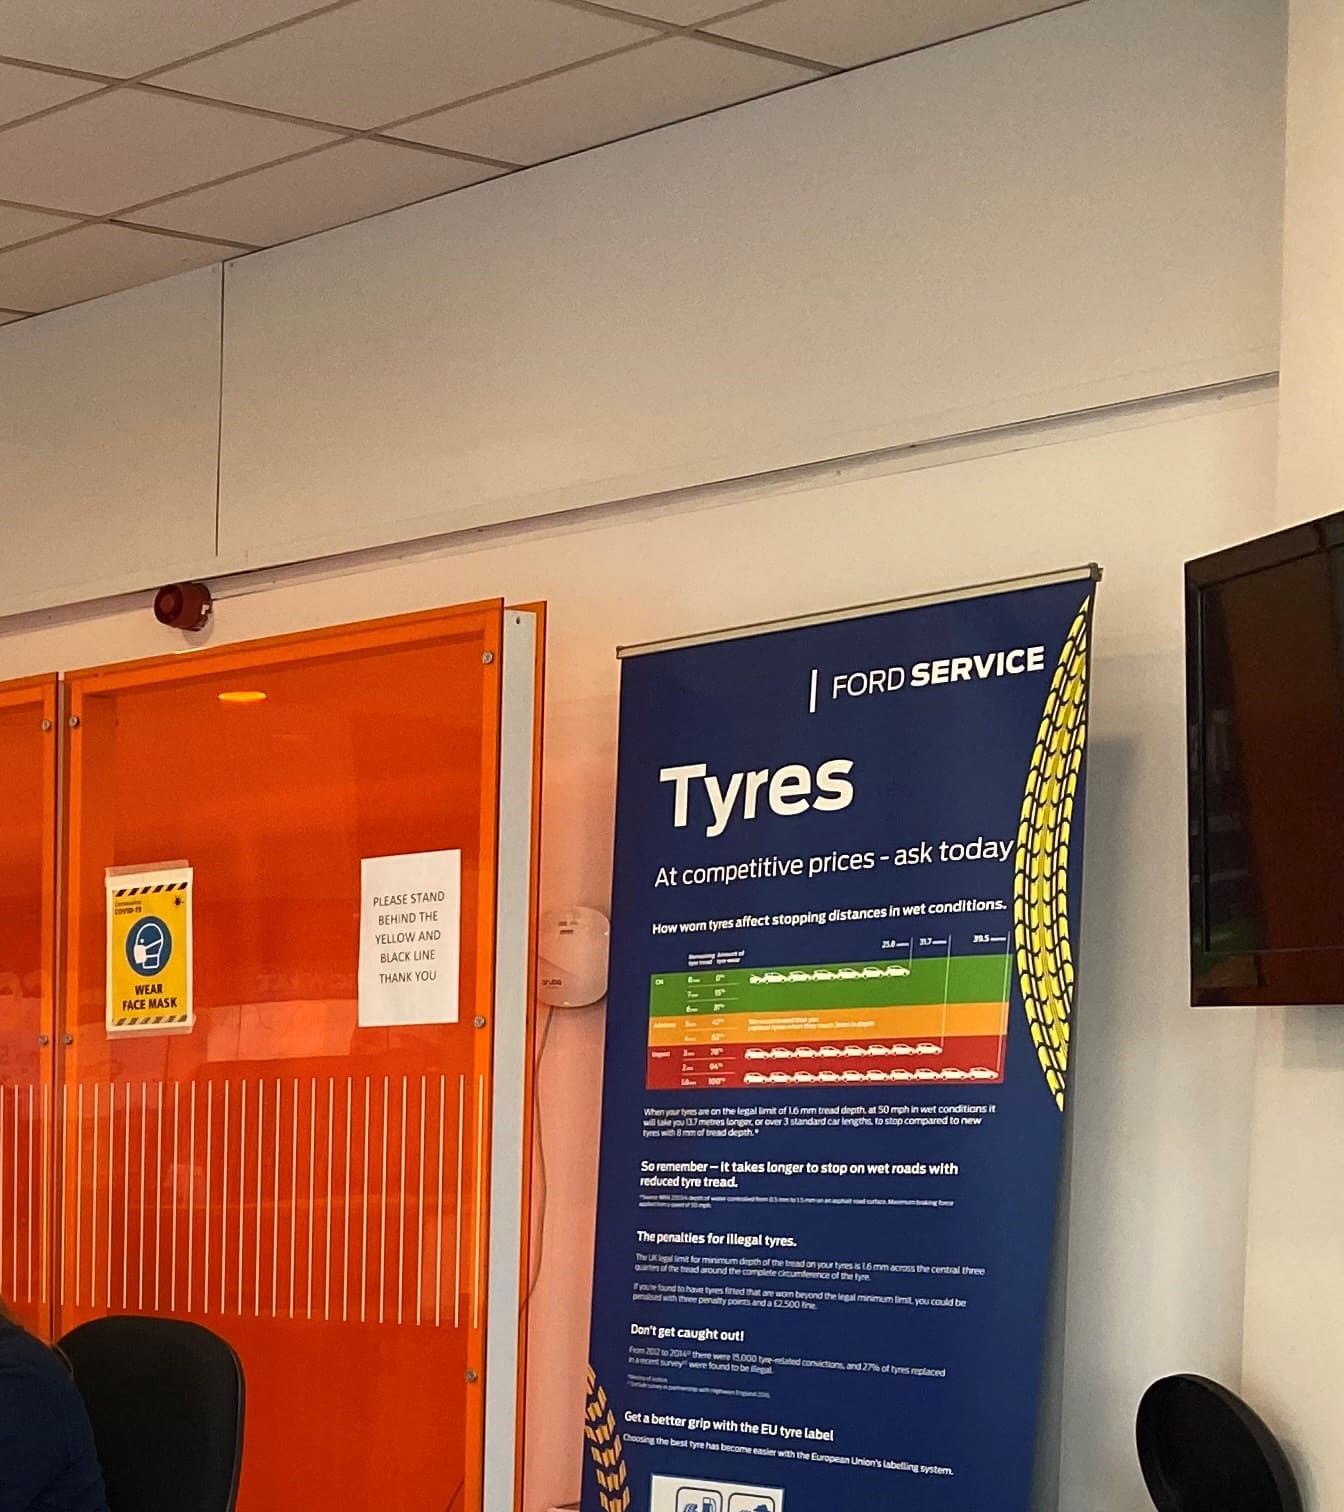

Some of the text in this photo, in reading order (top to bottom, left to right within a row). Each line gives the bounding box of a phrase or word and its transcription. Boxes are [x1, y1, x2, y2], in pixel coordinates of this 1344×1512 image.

[832, 646, 1045, 699] FORD SERVICE
[659, 758, 853, 838] Tyres
[655, 838, 1015, 888] At competitive prices ask today
[373, 891, 445, 907] PLEASE STAND
[378, 911, 438, 926] BEHIND THE
[652, 899, 1007, 935] How worn tyres affect stopping distances in wet conditions.
[375, 930, 441, 946] YELLOW AND
[380, 949, 436, 964] BLACK LINE
[379, 970, 436, 984] THANK YOU
[135, 984, 163, 996] WEAR
[123, 996, 177, 1011] FACE MASK
[641, 1161, 958, 1186] So remember it takes longer to stop on wet roads with
[640, 1176, 738, 1189] reduced tyre tread.
[637, 1231, 797, 1248] The penalties for illegal tyres.
